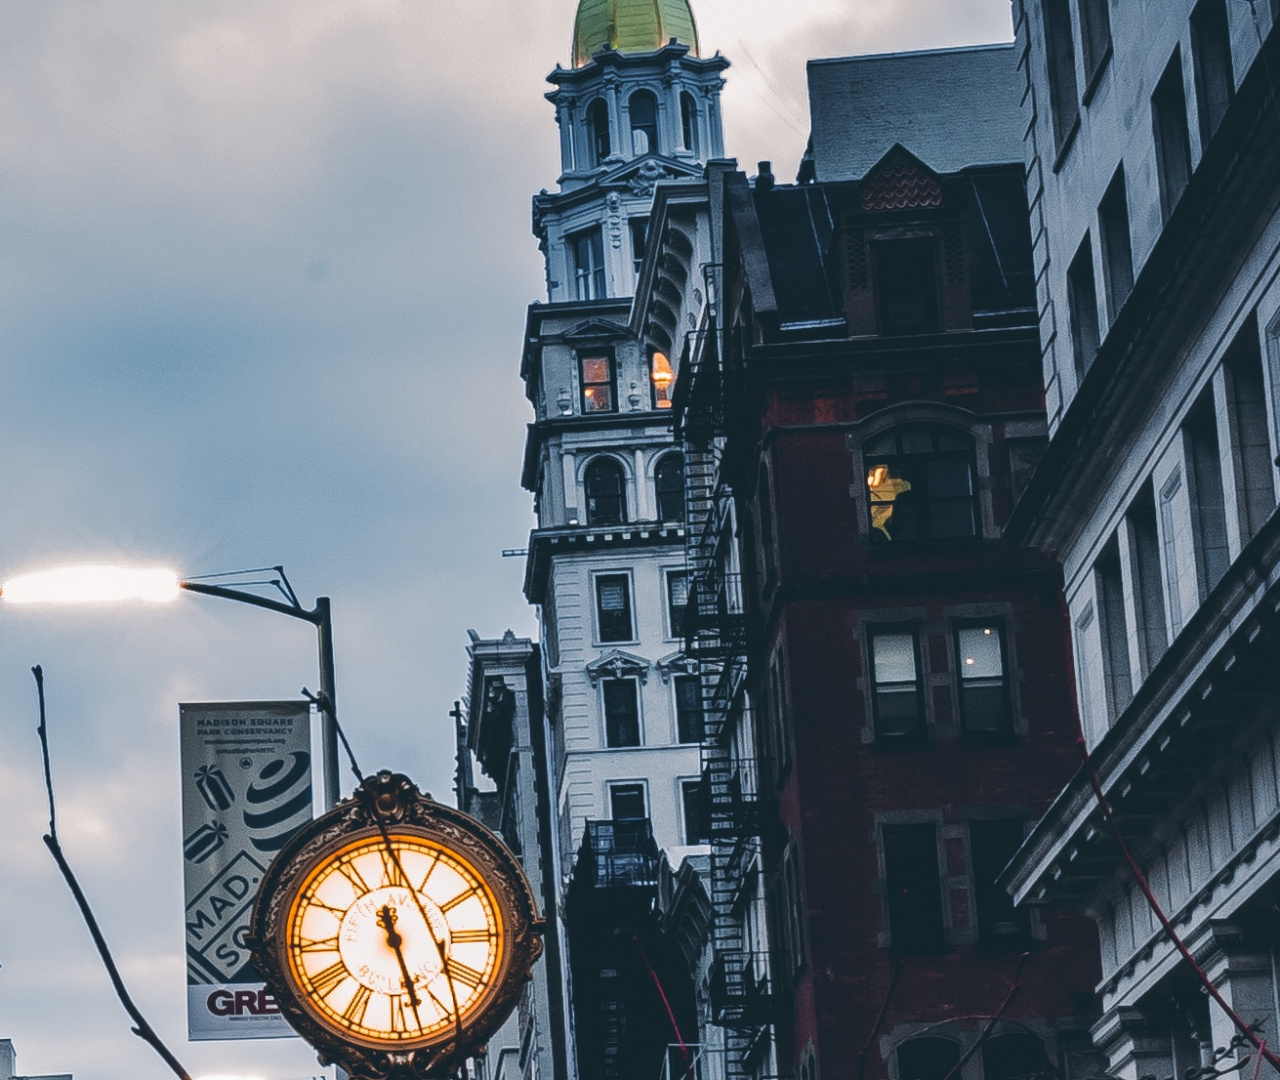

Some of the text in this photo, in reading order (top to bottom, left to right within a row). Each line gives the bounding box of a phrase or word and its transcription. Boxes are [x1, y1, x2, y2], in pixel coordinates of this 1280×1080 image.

[197, 718, 294, 727] MADISON SQUARE
[197, 728, 294, 736] PARK CONSERVANCY
[187, 874, 260, 941] MAD.
